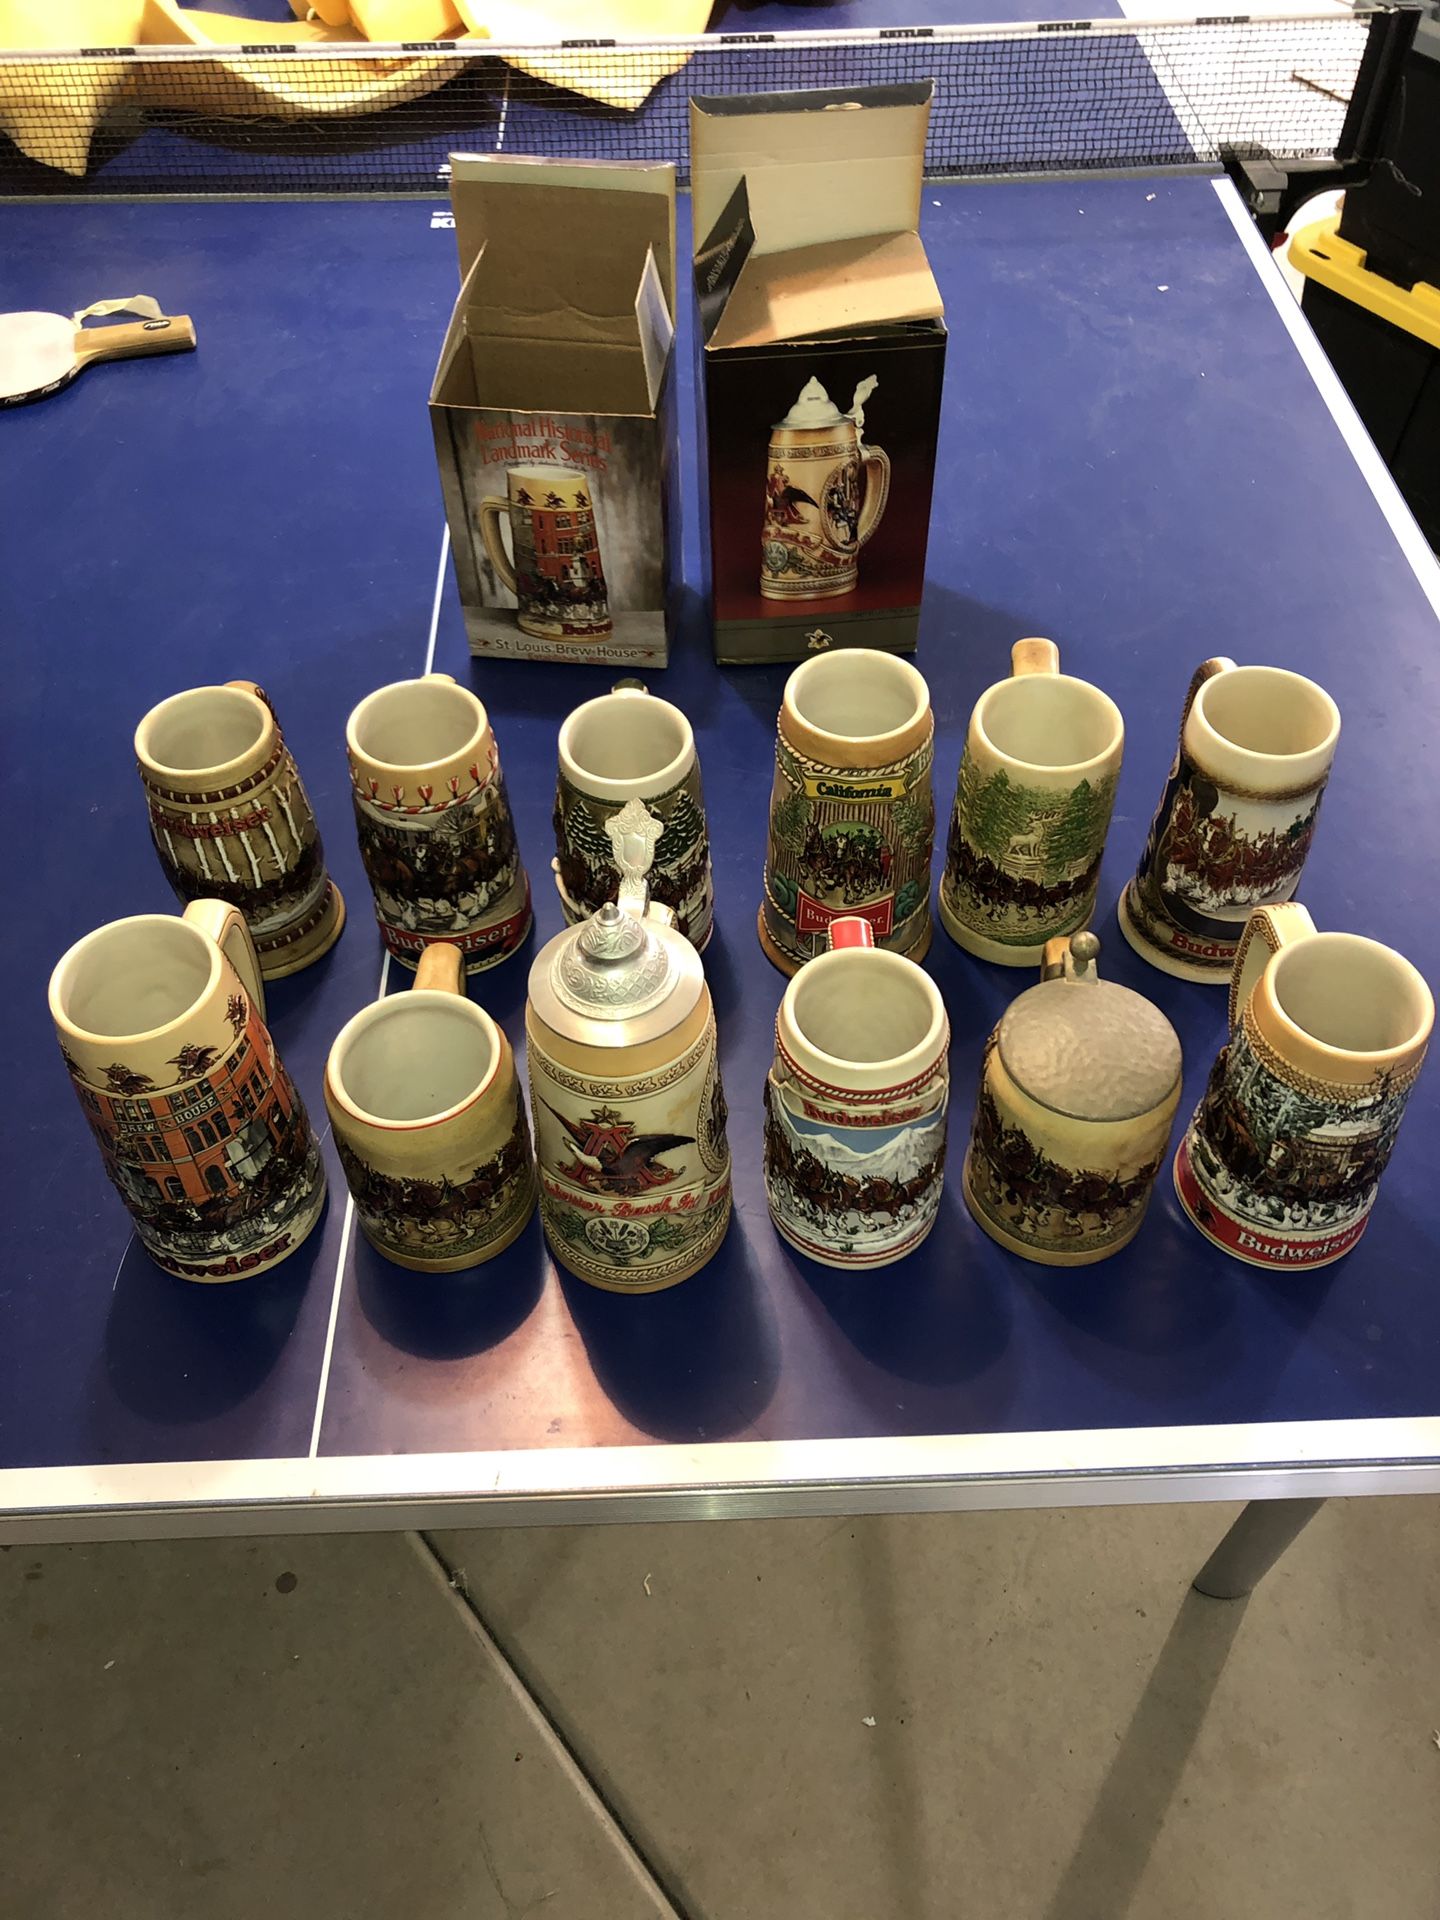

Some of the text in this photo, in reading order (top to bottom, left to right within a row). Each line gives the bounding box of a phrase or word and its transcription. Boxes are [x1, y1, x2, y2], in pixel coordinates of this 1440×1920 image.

[475, 418, 535, 440] National
[482, 439, 557, 465] Landmark
[560, 441, 608, 472] Series
[516, 640, 551, 653] Louis
[817, 781, 893, 799] California
[120, 1096, 218, 1133] BREW HOUSE
[802, 1099, 923, 1127] Budweiser
[1237, 1227, 1358, 1258] Budweiser
